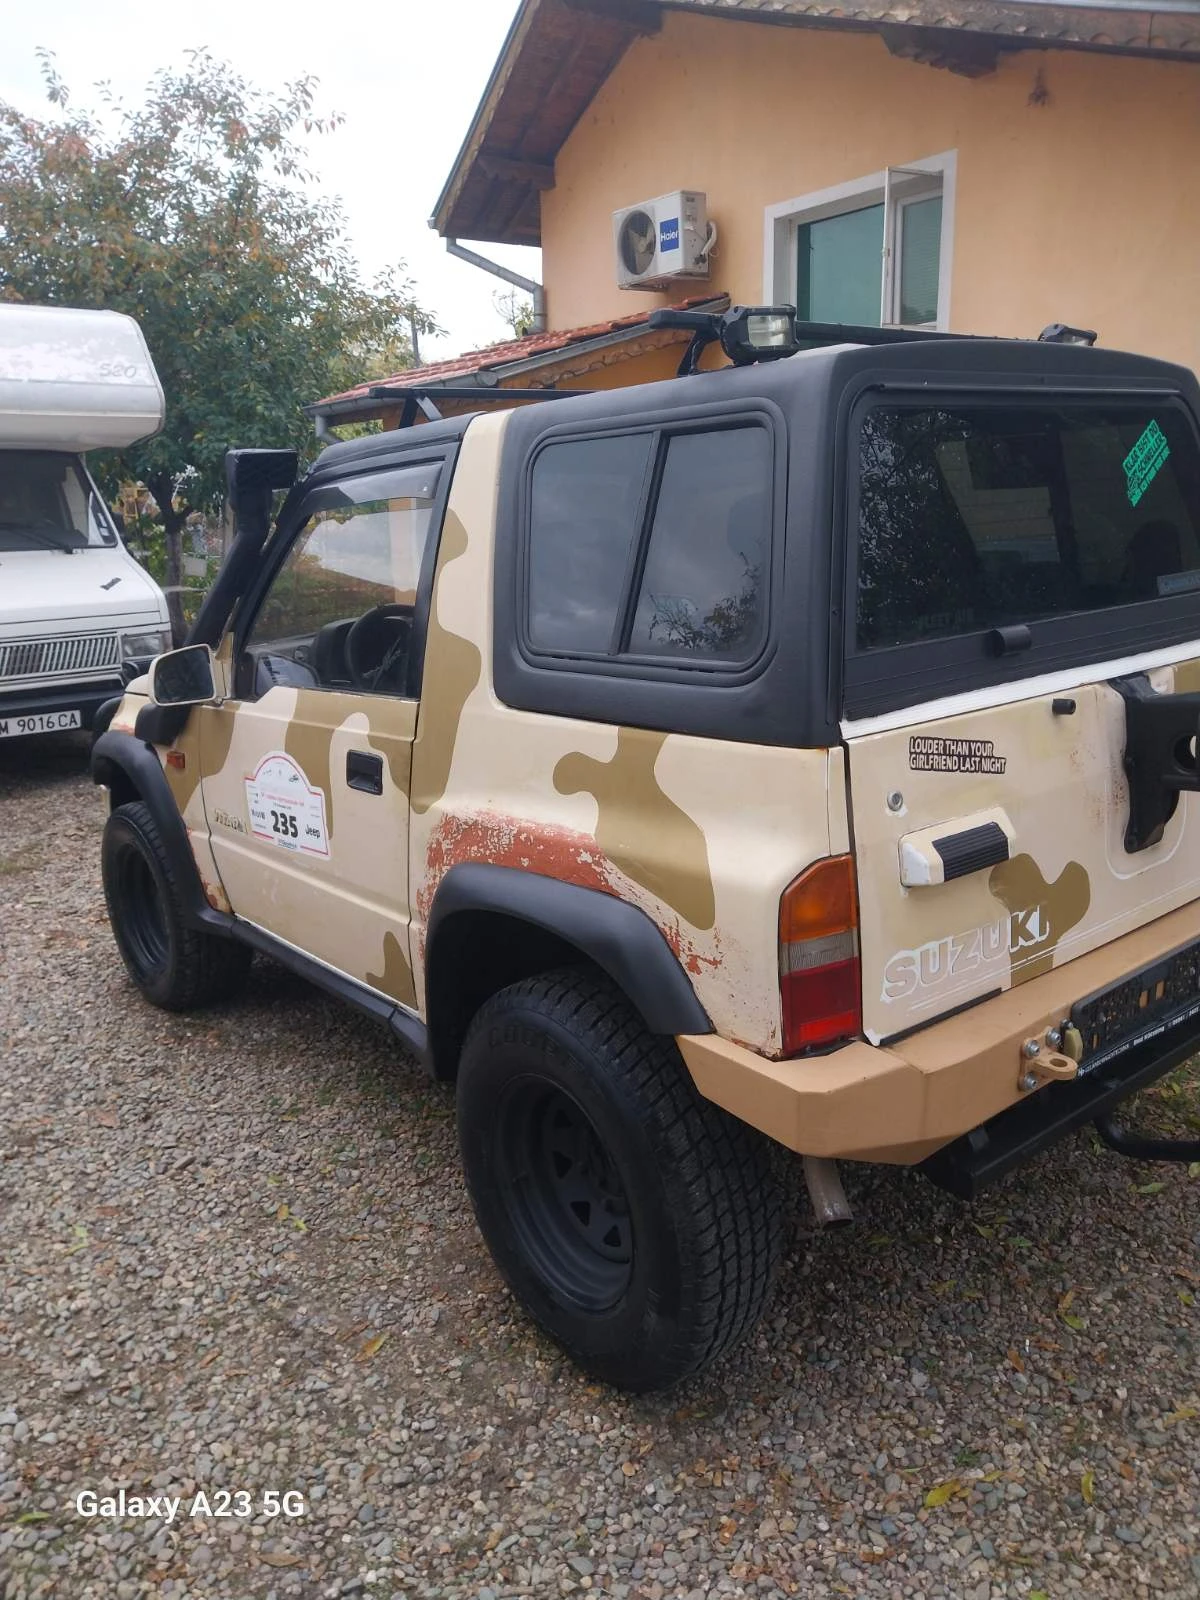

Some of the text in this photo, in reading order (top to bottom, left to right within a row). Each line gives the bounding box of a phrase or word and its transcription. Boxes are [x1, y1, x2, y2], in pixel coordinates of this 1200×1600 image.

[17, 717, 55, 732] 9016
[58, 713, 78, 727] CA
[910, 738, 993, 757] LOUDER THAN YOUR
[911, 755, 1006, 772] GIRLFRIEND LAST NIGHT
[270, 810, 298, 838] 235
[305, 823, 321, 839] Jeep
[882, 906, 1050, 1000] SUZUKI
